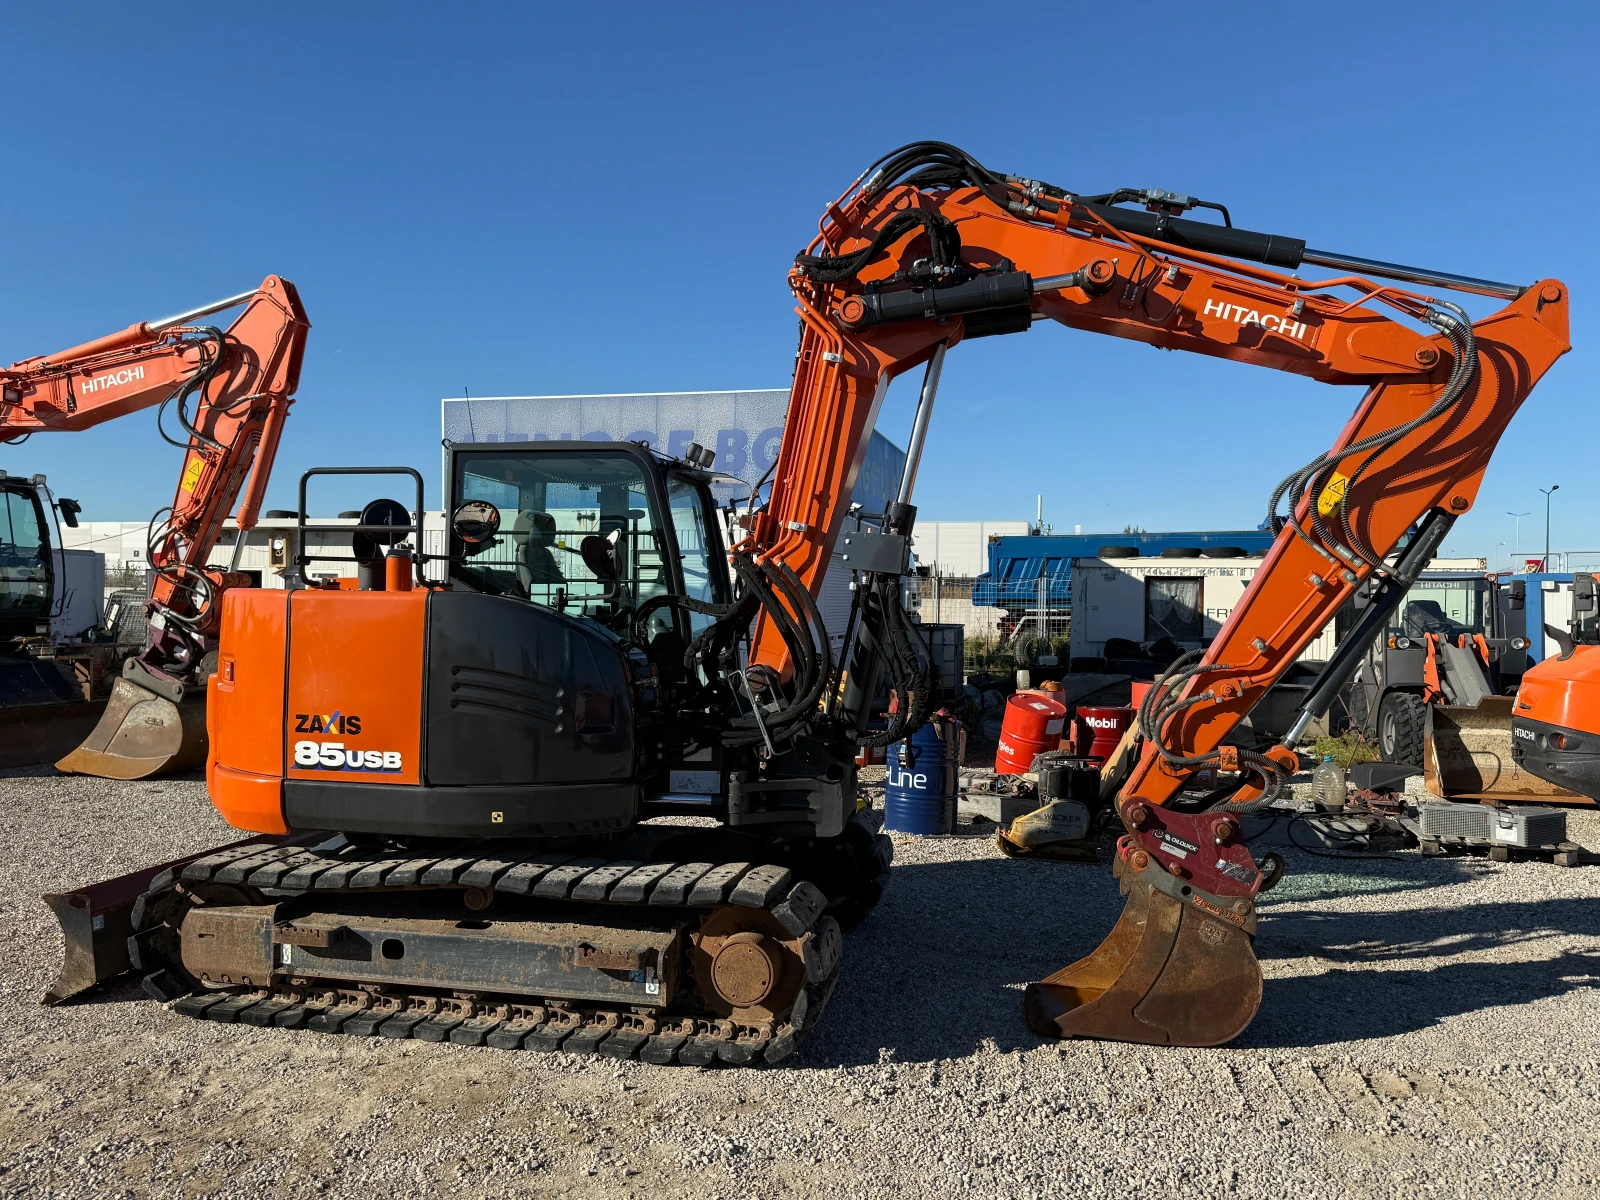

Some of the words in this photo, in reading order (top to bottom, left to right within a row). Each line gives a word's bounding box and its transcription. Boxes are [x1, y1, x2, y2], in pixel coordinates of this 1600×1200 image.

[1203, 299, 1307, 340] HITACHI
[81, 366, 145, 395] HITACHI
[295, 710, 362, 735] ZAXIS
[1085, 716, 1117, 729] Mobil
[1514, 727, 1535, 741] HITACHI
[1043, 813, 1081, 823] WACKER
